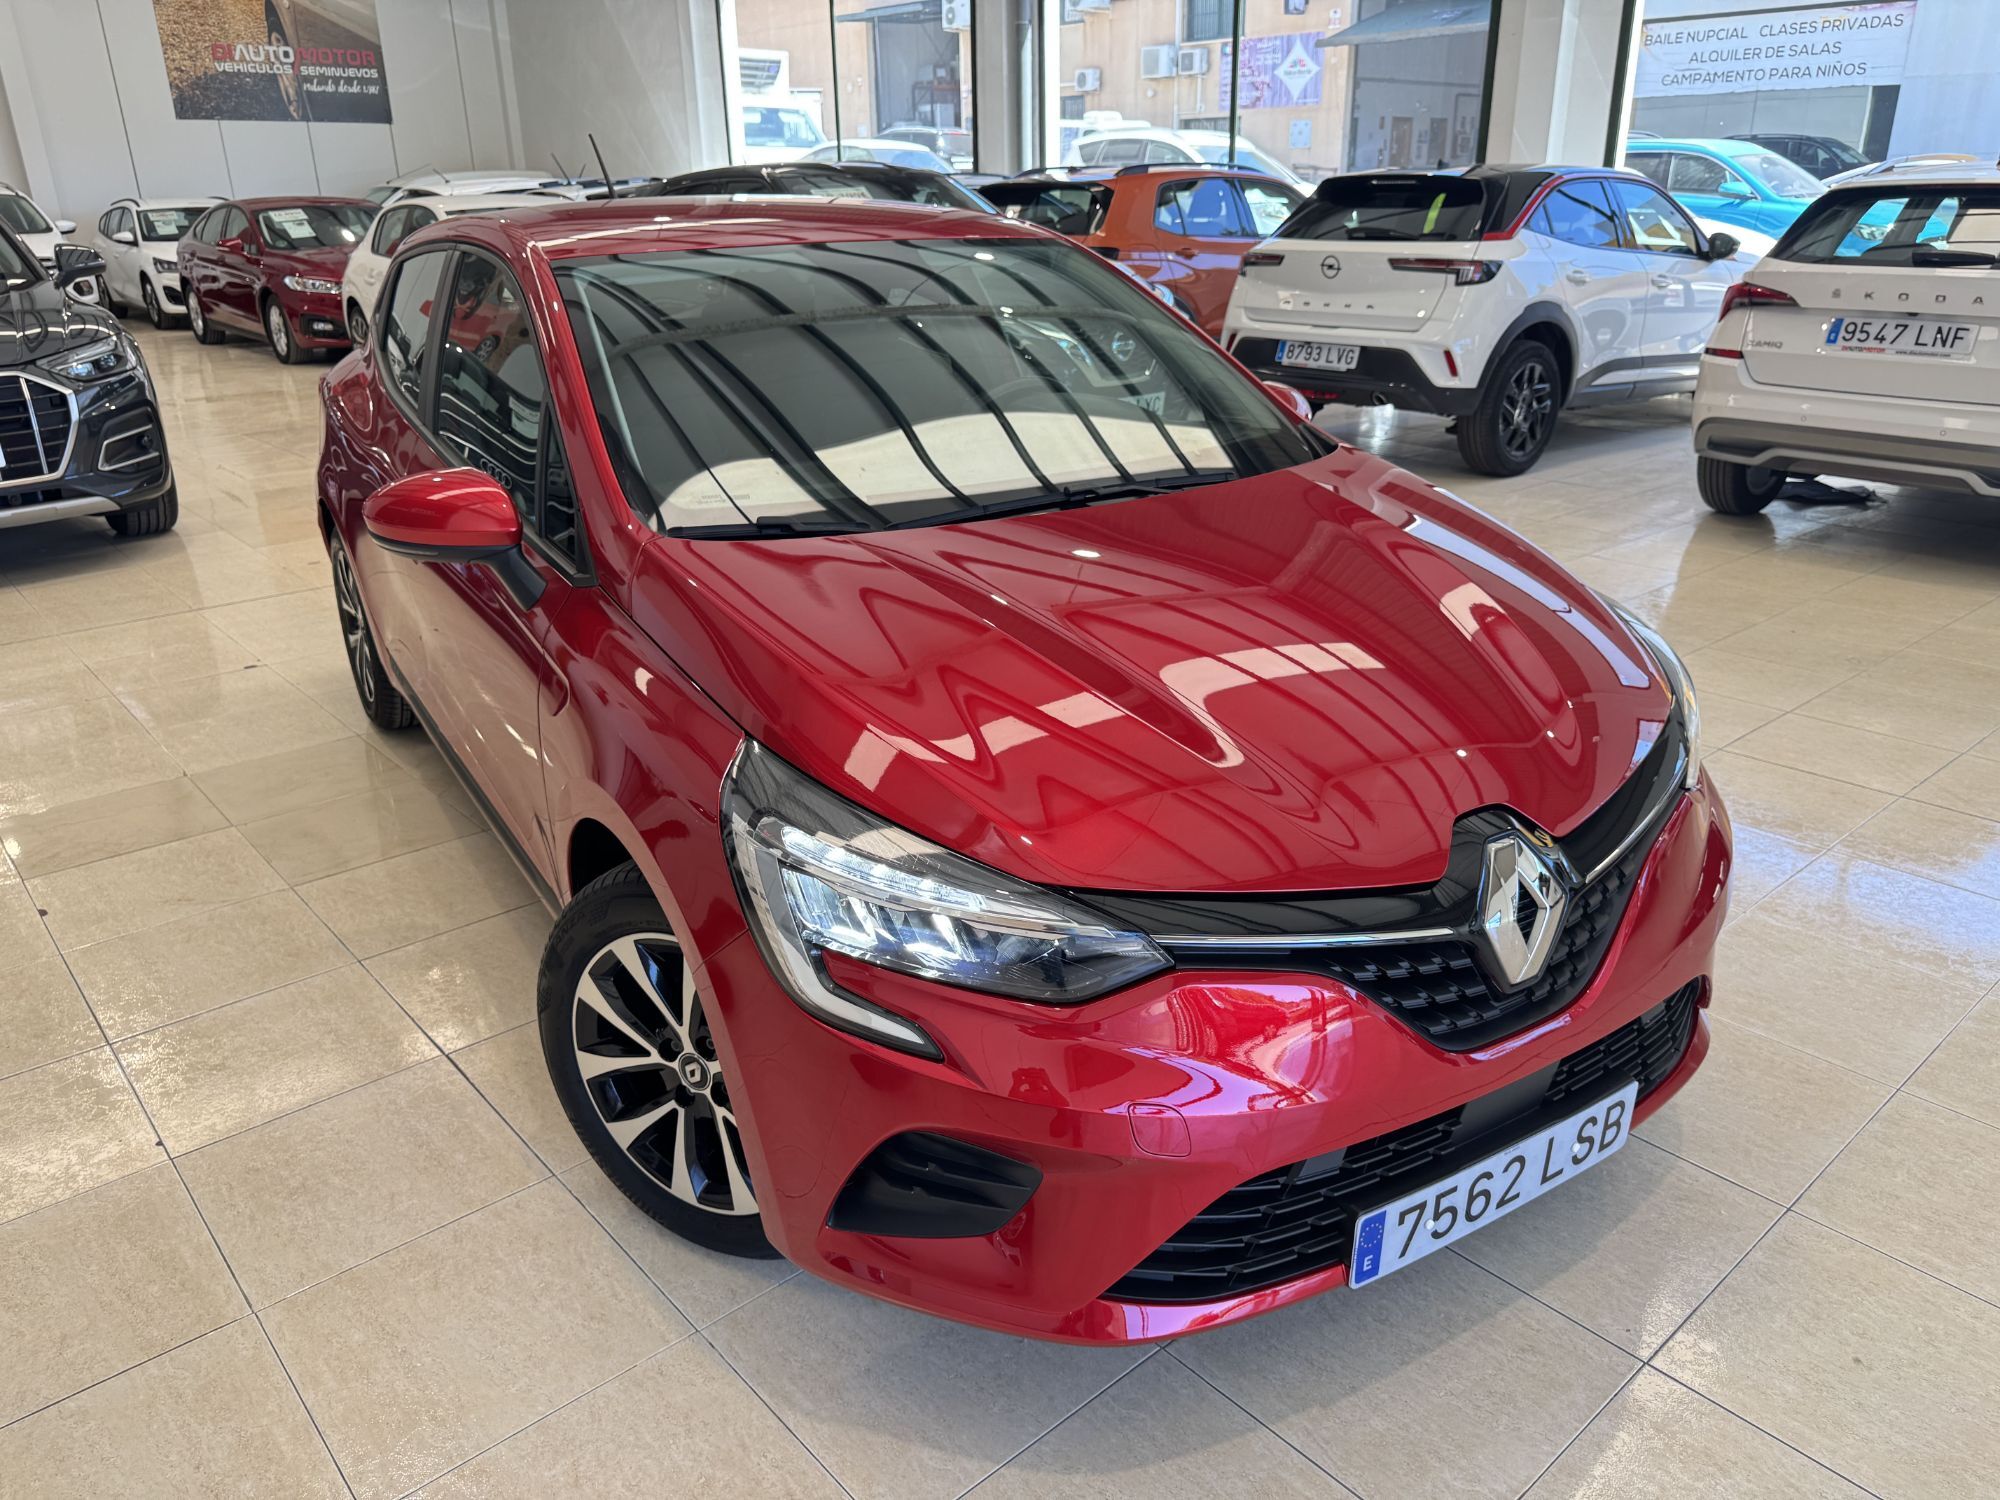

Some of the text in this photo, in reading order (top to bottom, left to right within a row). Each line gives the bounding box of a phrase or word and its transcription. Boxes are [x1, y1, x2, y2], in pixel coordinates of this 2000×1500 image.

[1644, 13, 1904, 46] BAILE NUPCIAL CLASES PRIVADAS
[1688, 41, 1842, 64] ALQUILER DE SALAS
[214, 62, 379, 79] VEHICULOS SEMINUEVOS
[1661, 60, 1867, 86] CAMPAMENTO PARA NIÑOS
[1841, 321, 1970, 349] 9547 LNF
[1286, 344, 1355, 366] 8793 LVG
[1397, 1099, 1627, 1260] 7562 LSB
[1362, 1255, 1374, 1272] E
